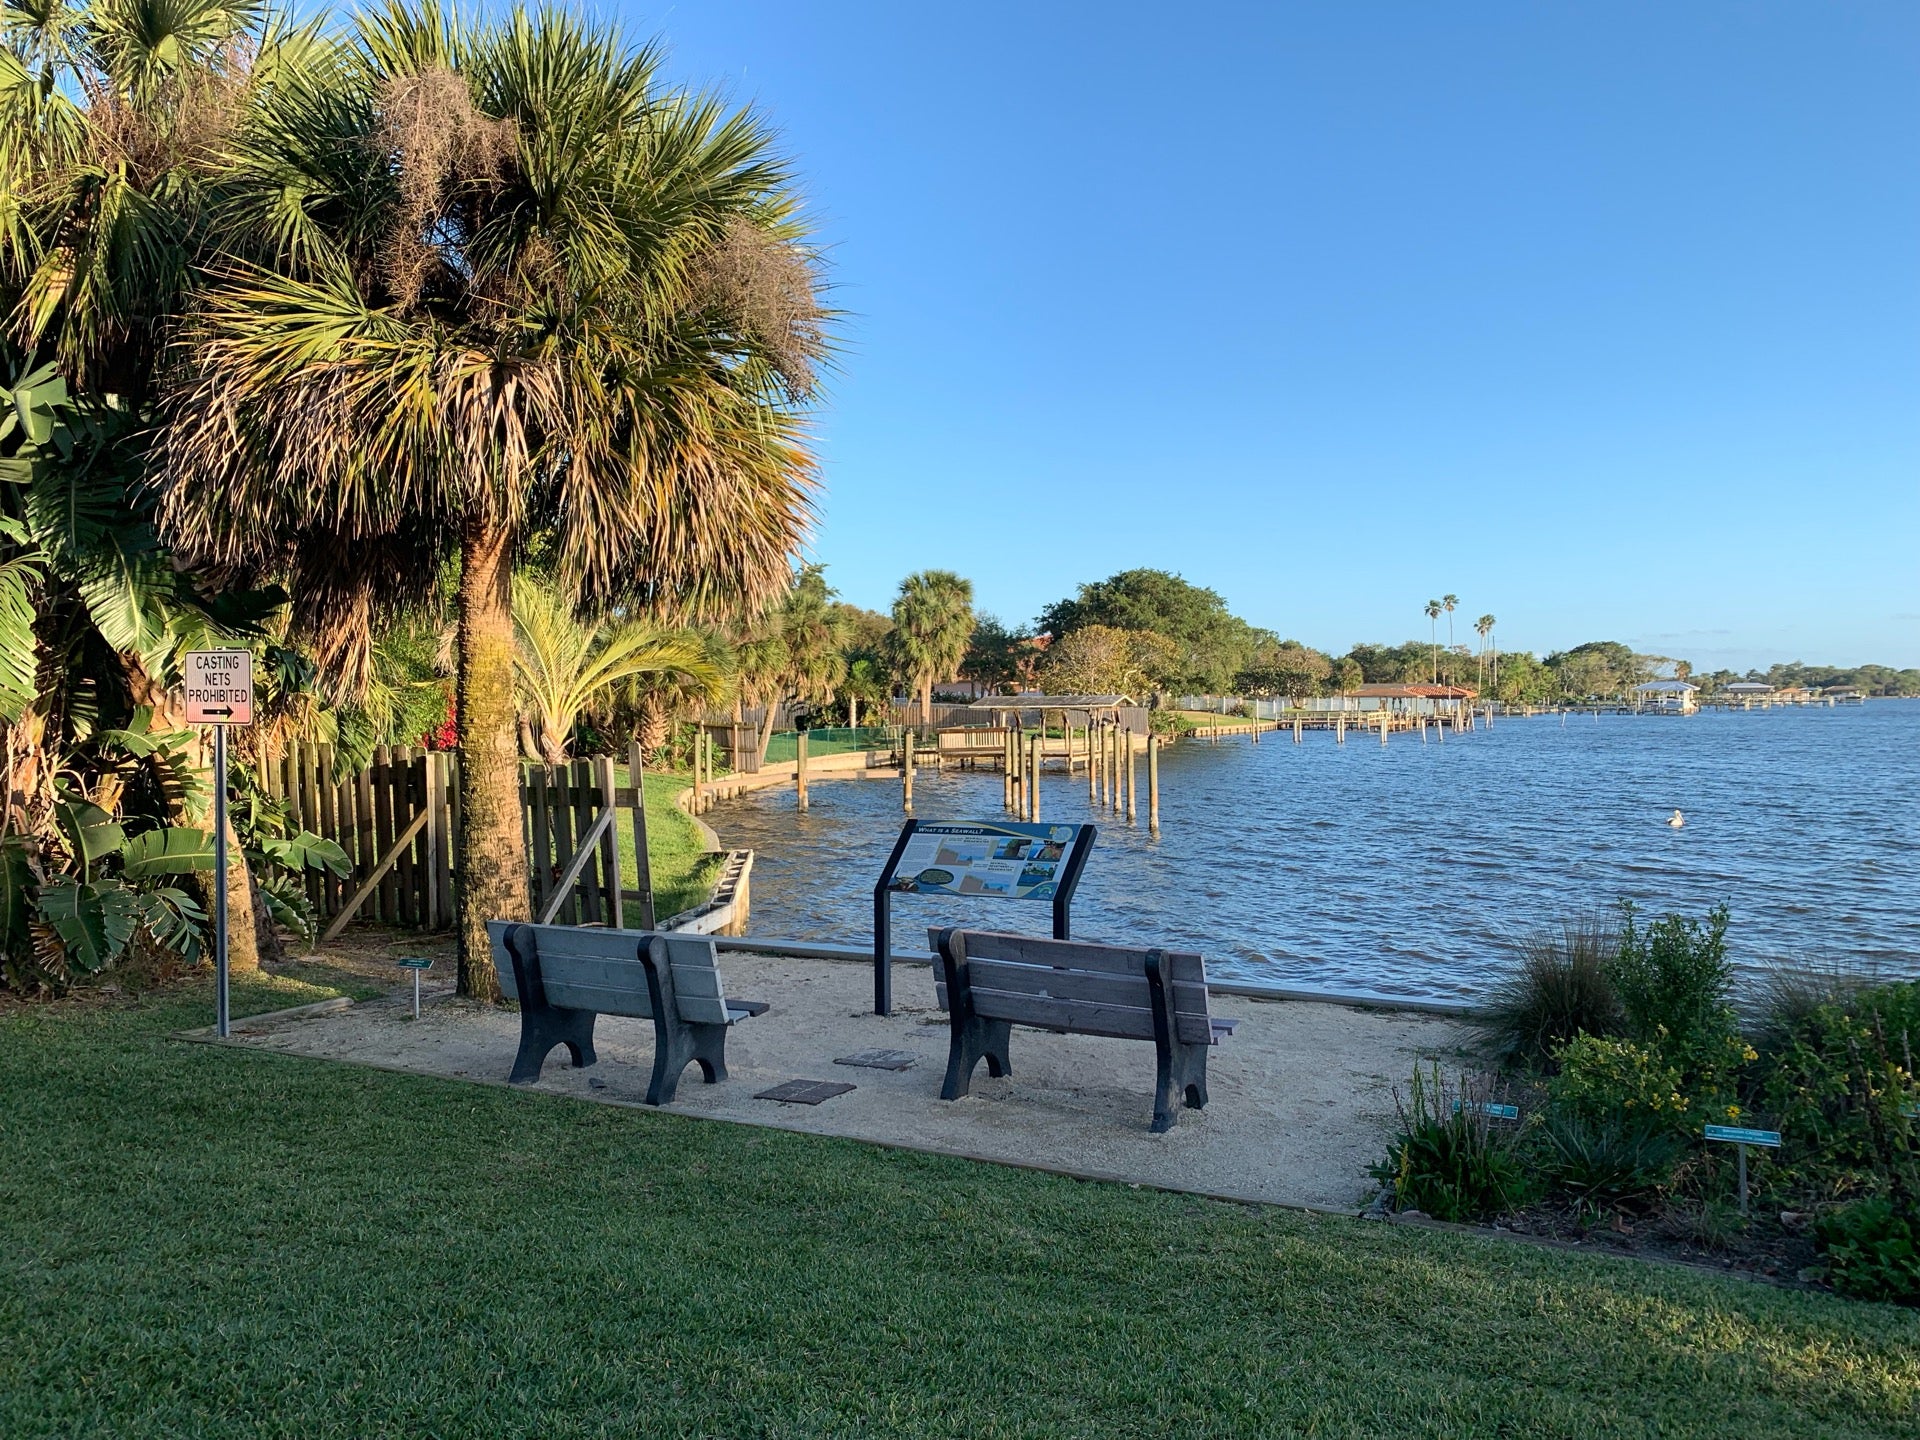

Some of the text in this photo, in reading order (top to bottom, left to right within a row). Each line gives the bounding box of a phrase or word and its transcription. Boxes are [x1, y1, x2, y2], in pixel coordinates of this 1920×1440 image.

[196, 656, 239, 670] CASTING
[205, 673, 231, 686] NETS
[189, 689, 247, 703] PROHIBITED
